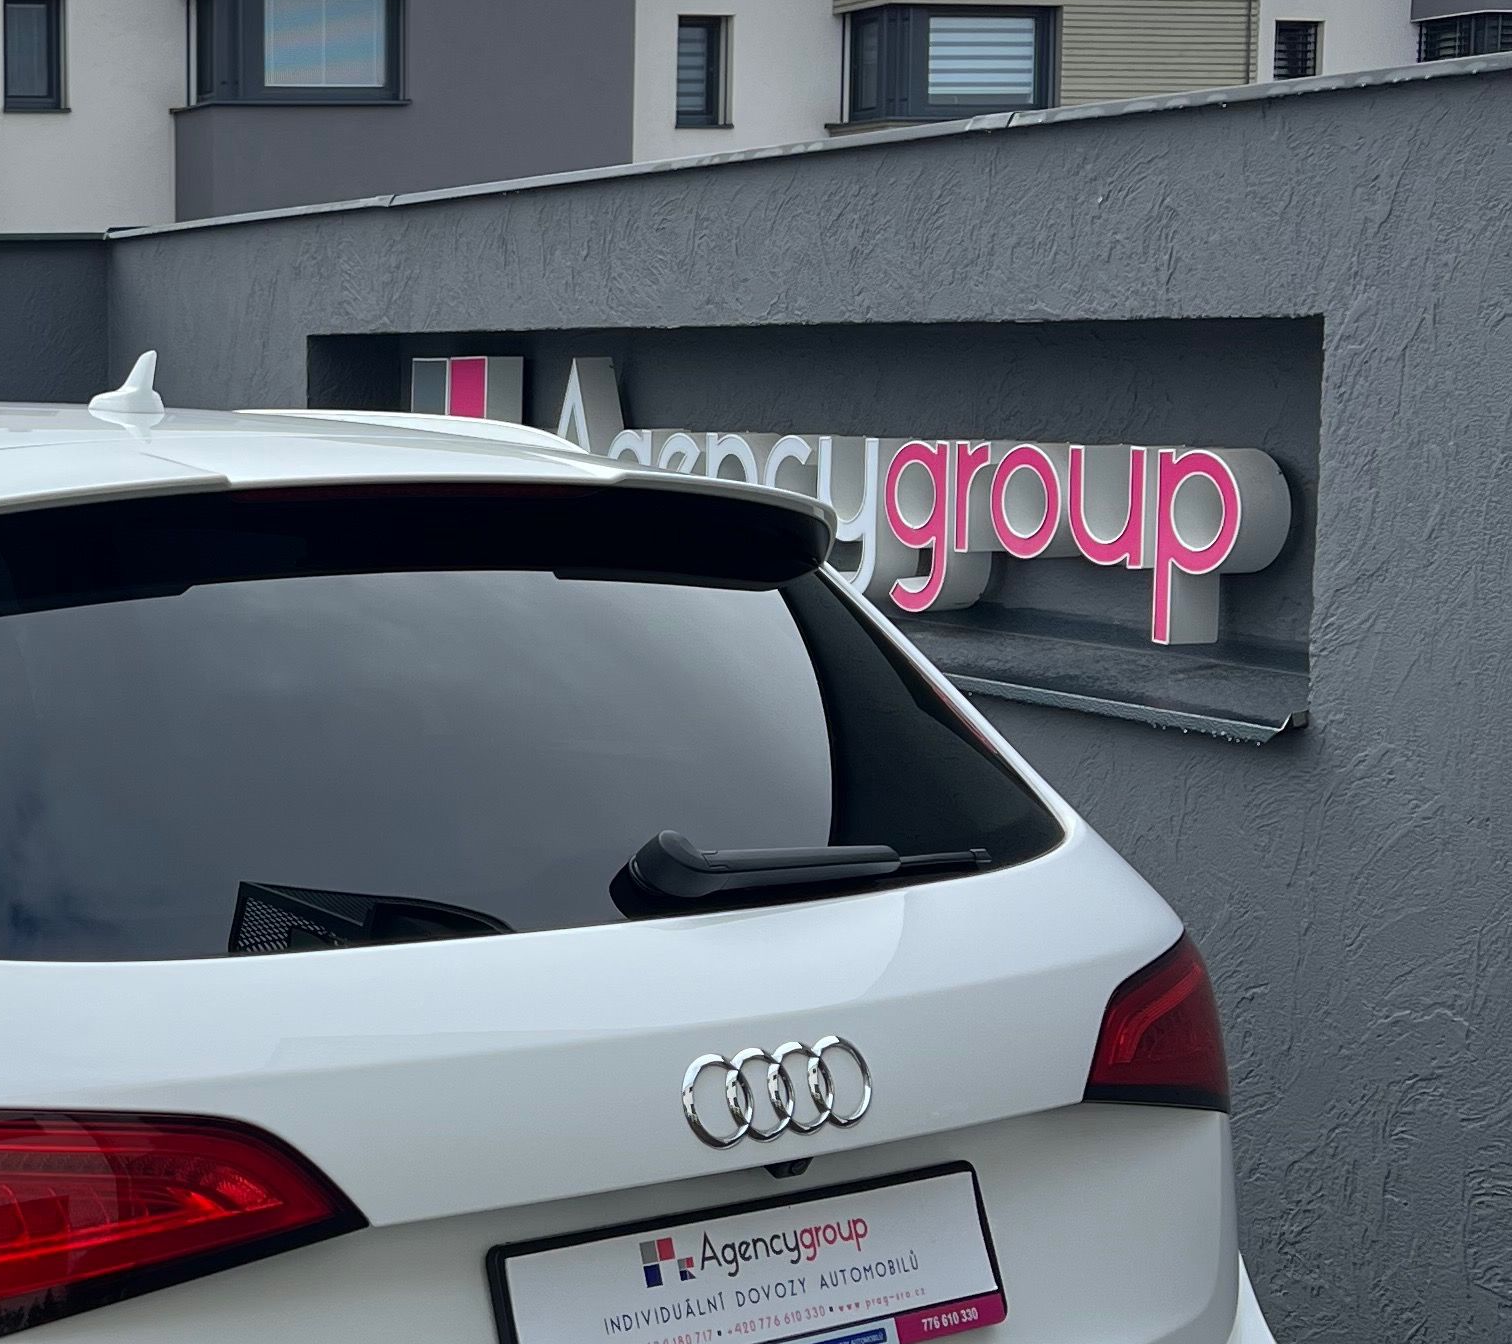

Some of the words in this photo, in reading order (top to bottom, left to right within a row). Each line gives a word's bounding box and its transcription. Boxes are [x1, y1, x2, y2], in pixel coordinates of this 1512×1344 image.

[556, 356, 1242, 645] Acygroup
[700, 1217, 868, 1277] Agencygroup
[604, 1291, 726, 1336] INDIVIDUÁLNÍ
[735, 1276, 807, 1308] DOVOZY
[819, 1249, 919, 1290] AUTOMOBILŮ
[921, 1315, 941, 1333] 776
[942, 1311, 961, 1328] 610
[961, 1307, 979, 1323] 330
